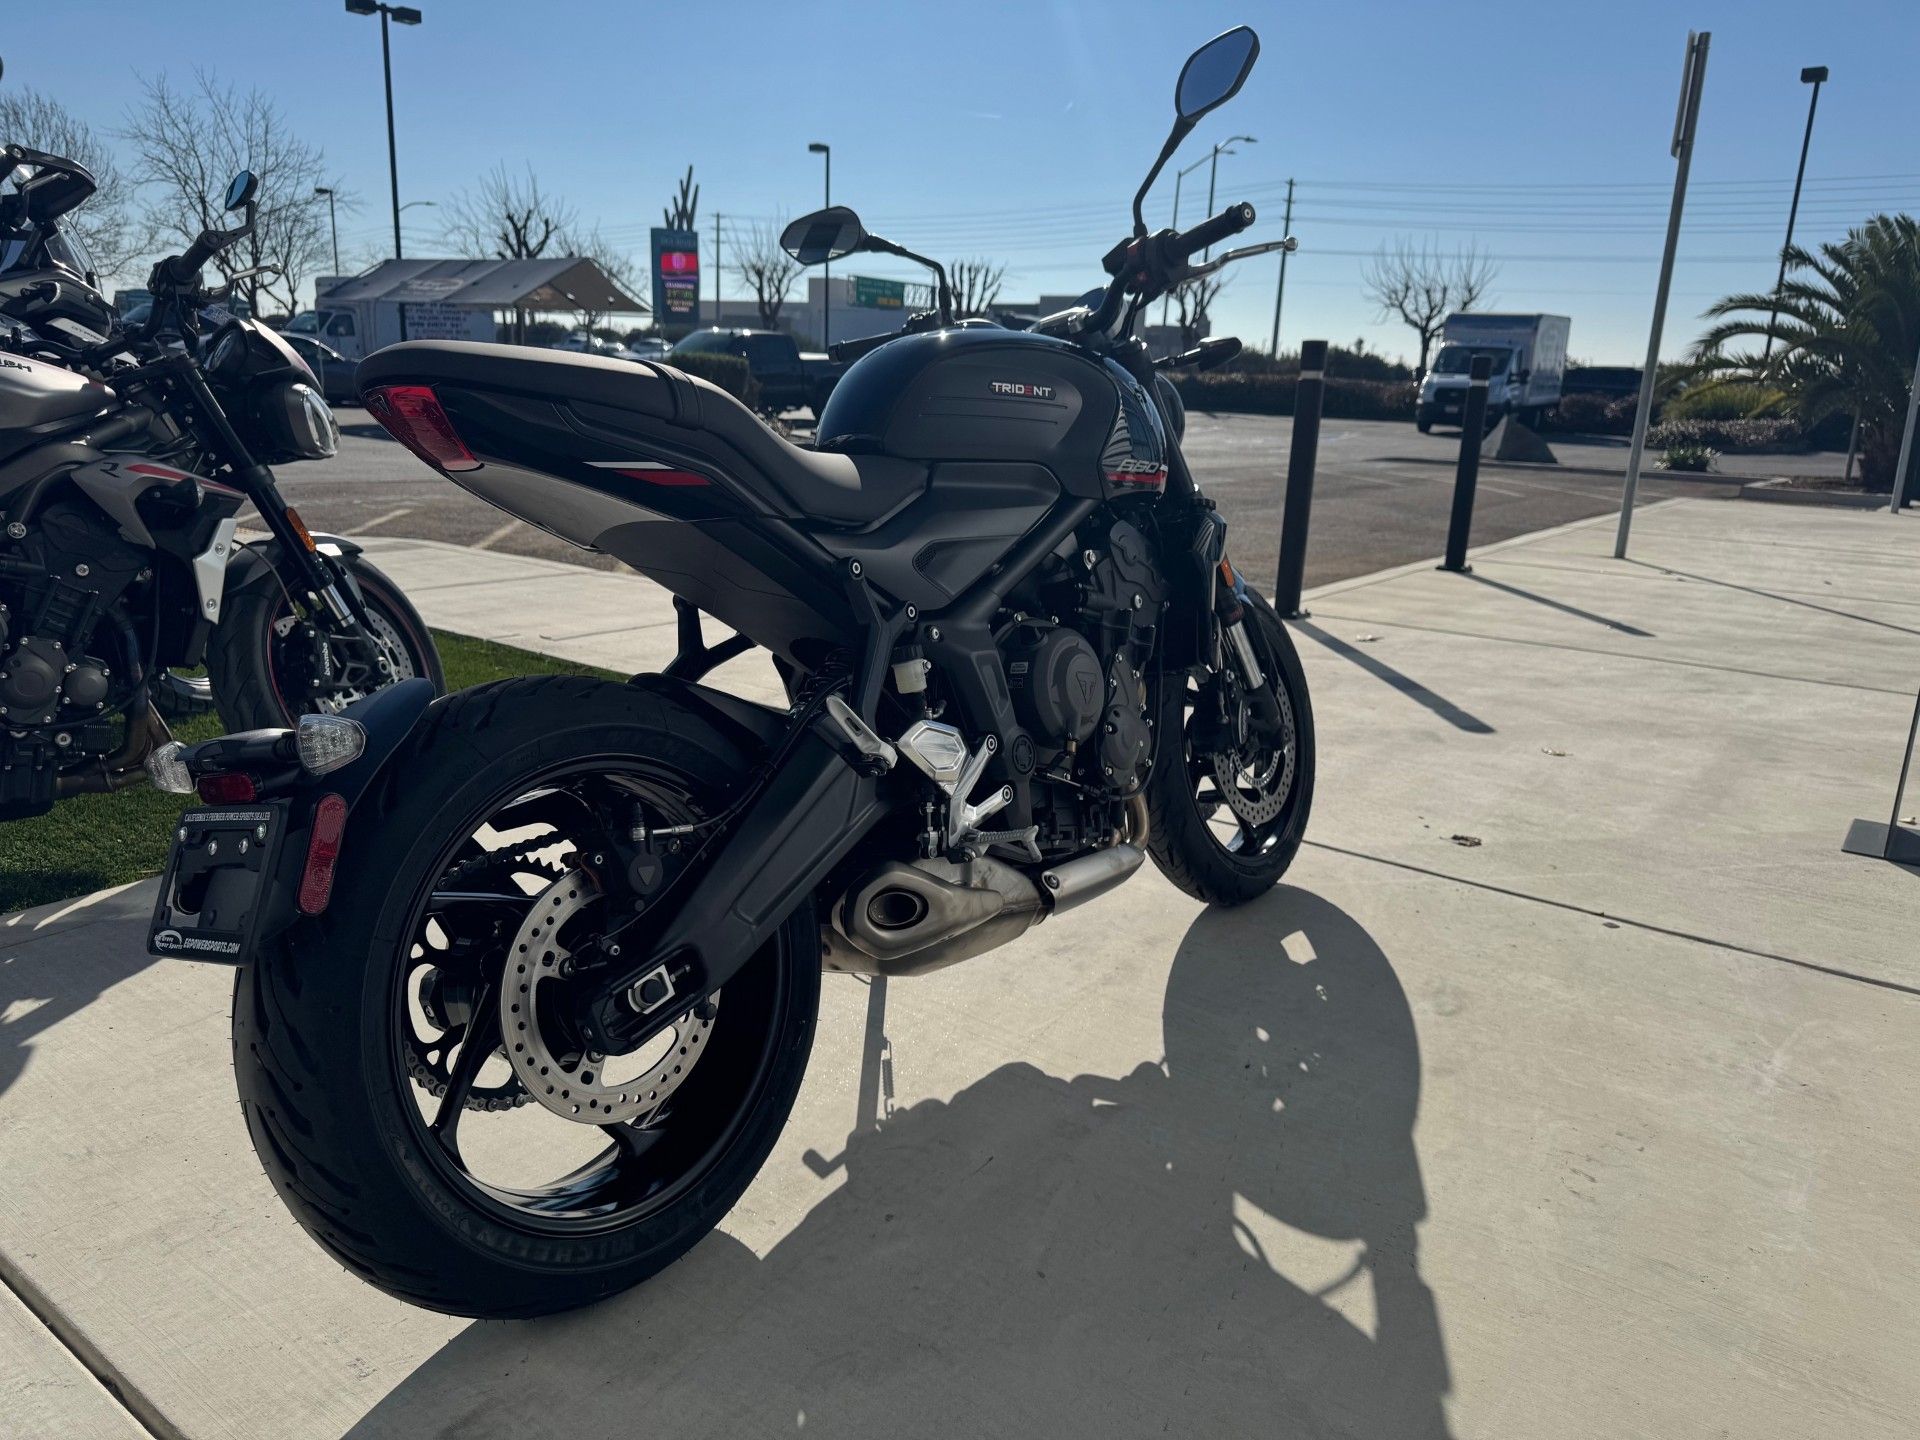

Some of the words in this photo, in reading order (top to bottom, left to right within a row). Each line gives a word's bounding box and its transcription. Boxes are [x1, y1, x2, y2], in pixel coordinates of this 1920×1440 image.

[992, 382, 1052, 397] TRIDENT
[1117, 459, 1160, 474] 660
[322, 643, 331, 675] brembo
[169, 942, 184, 950] Sports
[184, 938, 240, 953] EGPOWERSPORTS.COM
